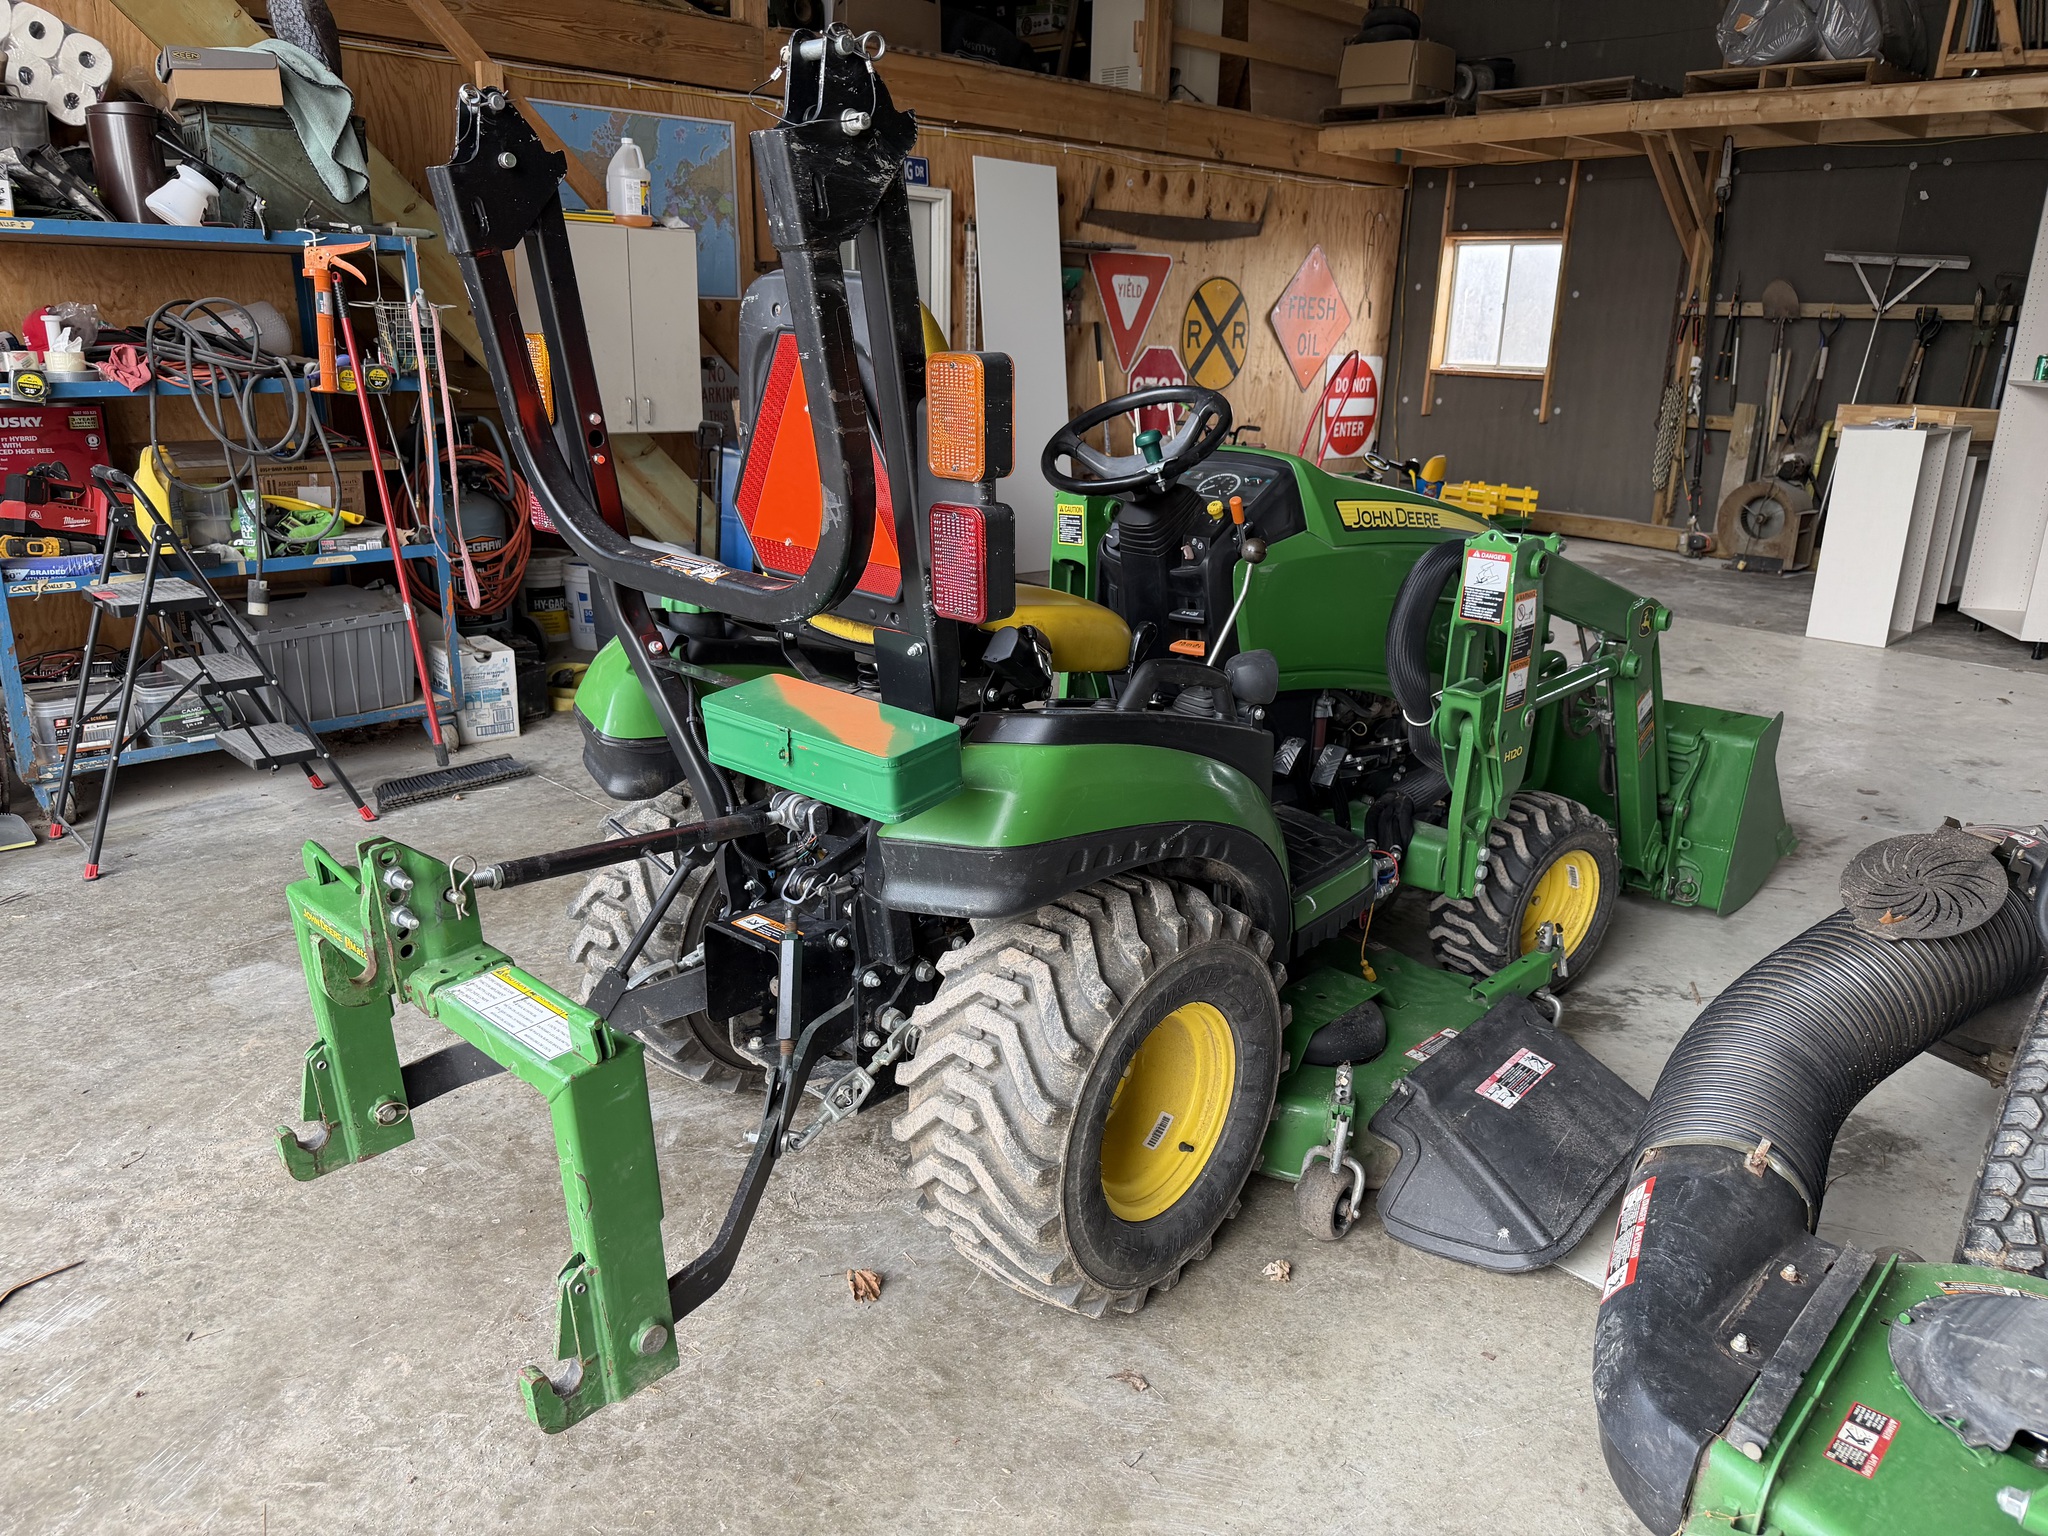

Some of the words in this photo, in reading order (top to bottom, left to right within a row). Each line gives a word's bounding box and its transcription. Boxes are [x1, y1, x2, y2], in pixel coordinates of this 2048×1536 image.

[172, 50, 200, 59] KEEN
[962, 38, 997, 55] SALUSPA
[914, 165, 925, 178] DR
[1118, 283, 1142, 299] YIELD
[1287, 296, 1338, 321] FRESH
[1187, 320, 1203, 349] R
[1232, 321, 1247, 350] R
[1297, 333, 1320, 357] OIL
[708, 366, 726, 383] NO
[1335, 377, 1348, 394] DO
[1353, 377, 1372, 394] NOT
[702, 386, 740, 403] ARKING
[0, 416, 42, 428] USKY
[709, 410, 729, 422] THIS
[1333, 421, 1365, 438] ENTER
[1064, 505, 1083, 513] CAUTION
[1352, 507, 1393, 526] JOHN
[1395, 507, 1441, 527] DEERE
[63, 516, 91, 525] Milwaukee
[1480, 552, 1507, 561] DANGER
[534, 598, 567, 610] HY-GAR
[181, 706, 202, 714] CAMO
[1503, 746, 1523, 763] H120
